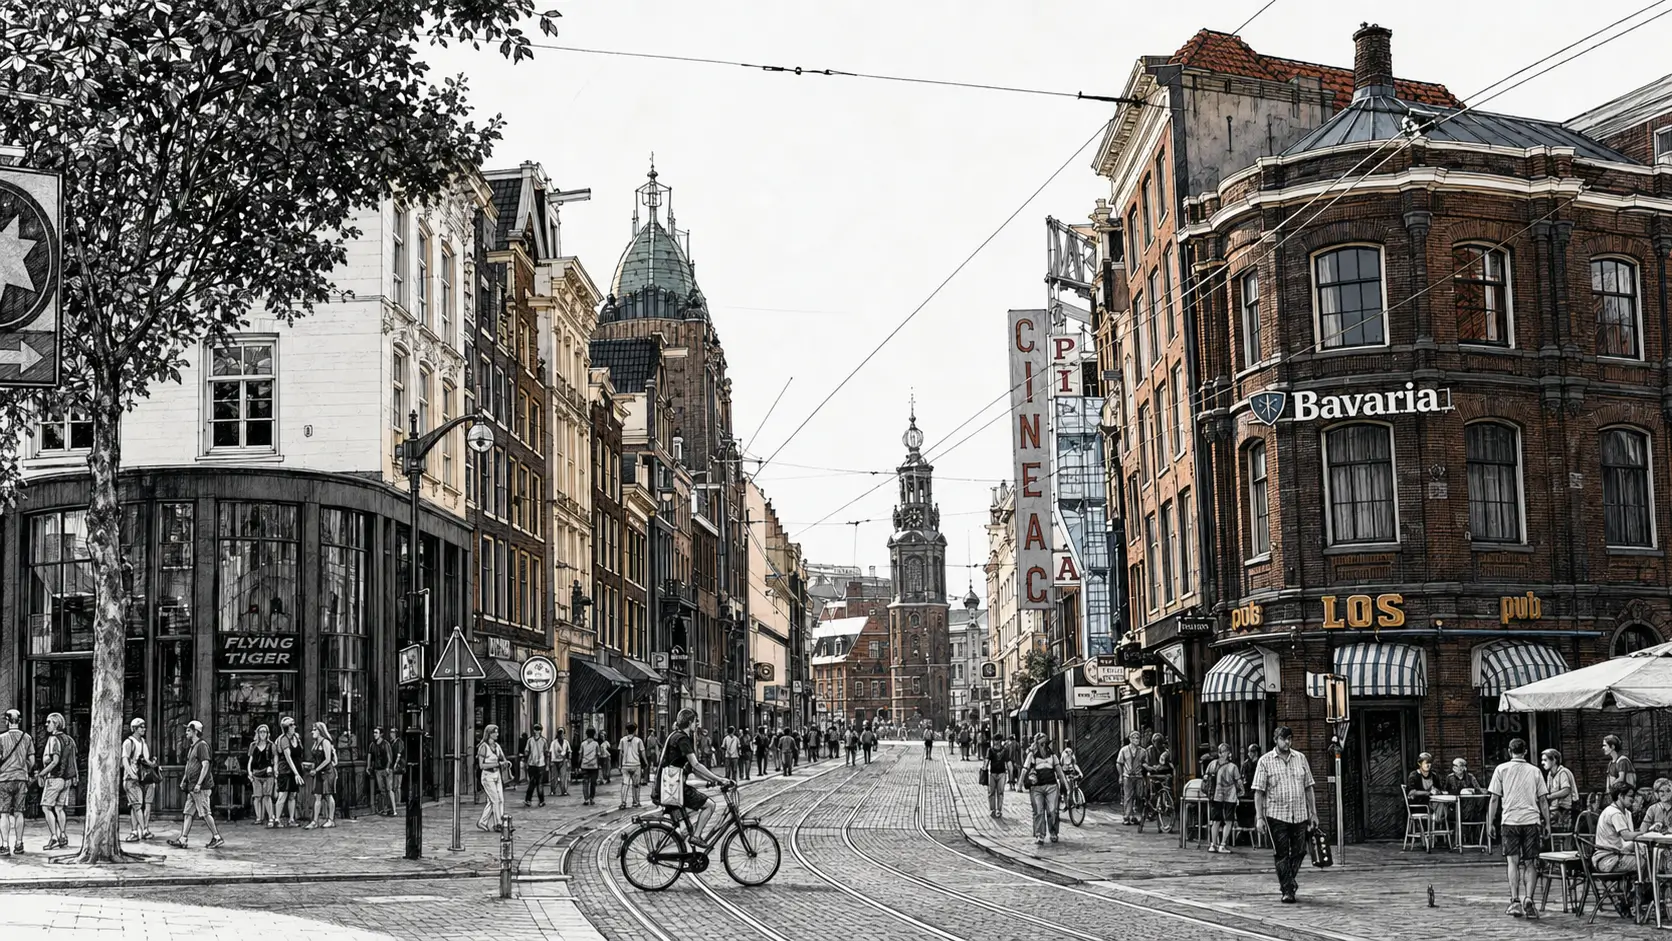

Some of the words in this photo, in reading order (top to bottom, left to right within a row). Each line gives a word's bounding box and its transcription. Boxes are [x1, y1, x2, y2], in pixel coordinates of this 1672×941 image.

[1291, 382, 1442, 422] Bavaria
[1015, 318, 1047, 603] CINEAC
[1231, 601, 1263, 631] pub
[1321, 593, 1405, 628] LOS
[1500, 591, 1542, 625] pub
[224, 637, 294, 649] FLYING
[225, 652, 291, 665] TIGER
[1483, 713, 1522, 732] LOS
